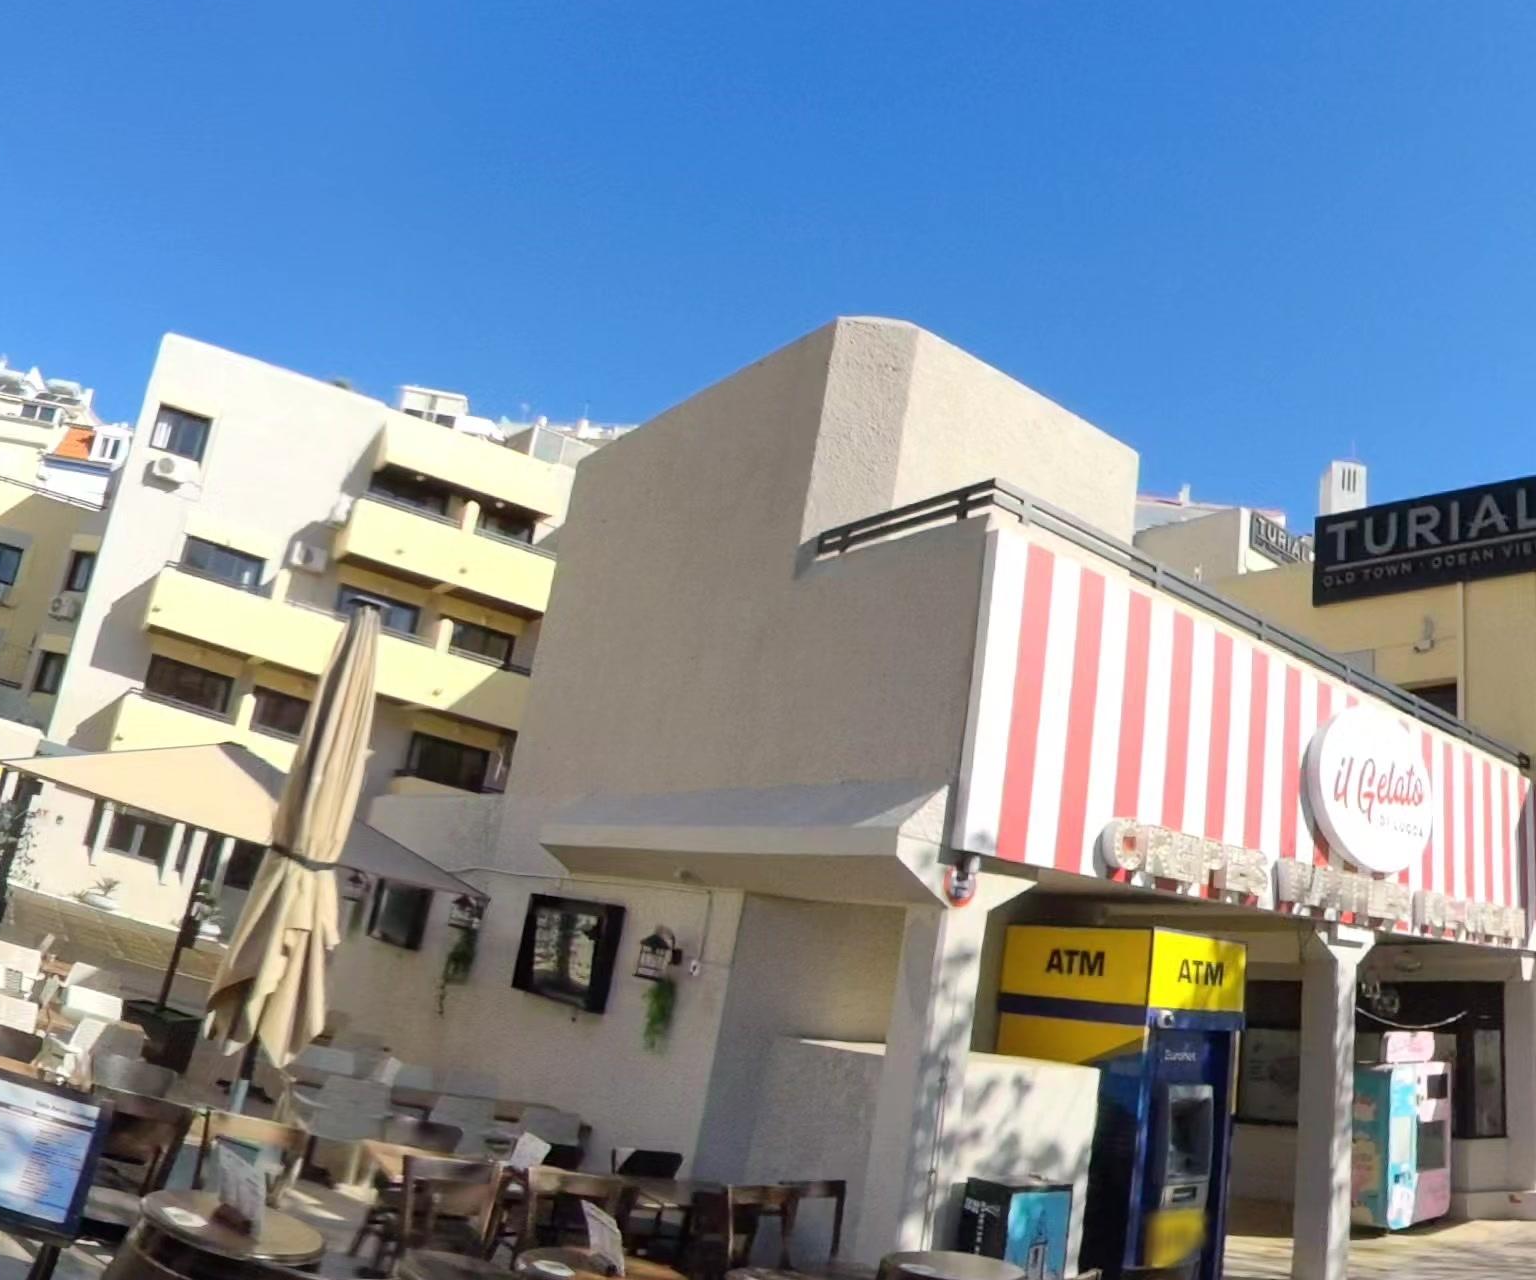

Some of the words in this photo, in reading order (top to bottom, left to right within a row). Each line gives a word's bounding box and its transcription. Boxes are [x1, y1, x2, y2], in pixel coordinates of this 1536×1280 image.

[1257, 516, 1309, 562] TURIAL
[1323, 572, 1356, 589] OLD
[1364, 561, 1412, 580] TOWN
[1432, 547, 1494, 569] OCEAN
[1334, 757, 1354, 808] il
[1357, 758, 1424, 824] Gelato
[1045, 949, 1105, 977] ATM
[1177, 958, 1225, 987] ATM
